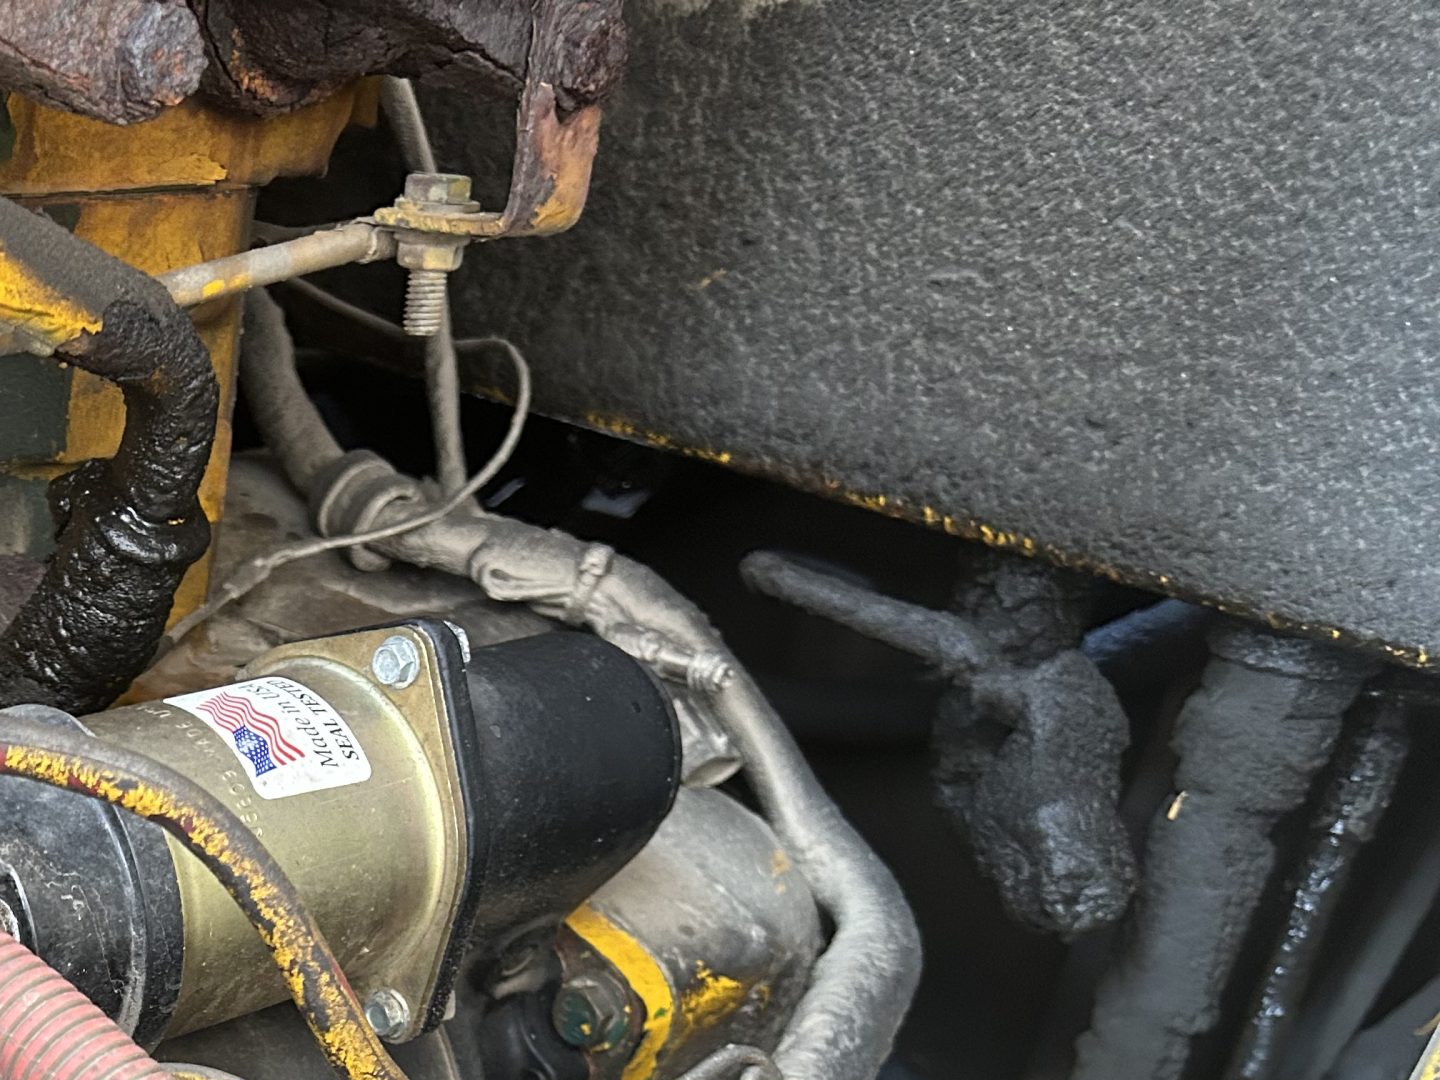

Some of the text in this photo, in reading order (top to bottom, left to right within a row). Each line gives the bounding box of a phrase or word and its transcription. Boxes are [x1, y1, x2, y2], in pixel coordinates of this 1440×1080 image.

[238, 683, 339, 768] Made in USA
[266, 679, 360, 761] SEAL TESTED
